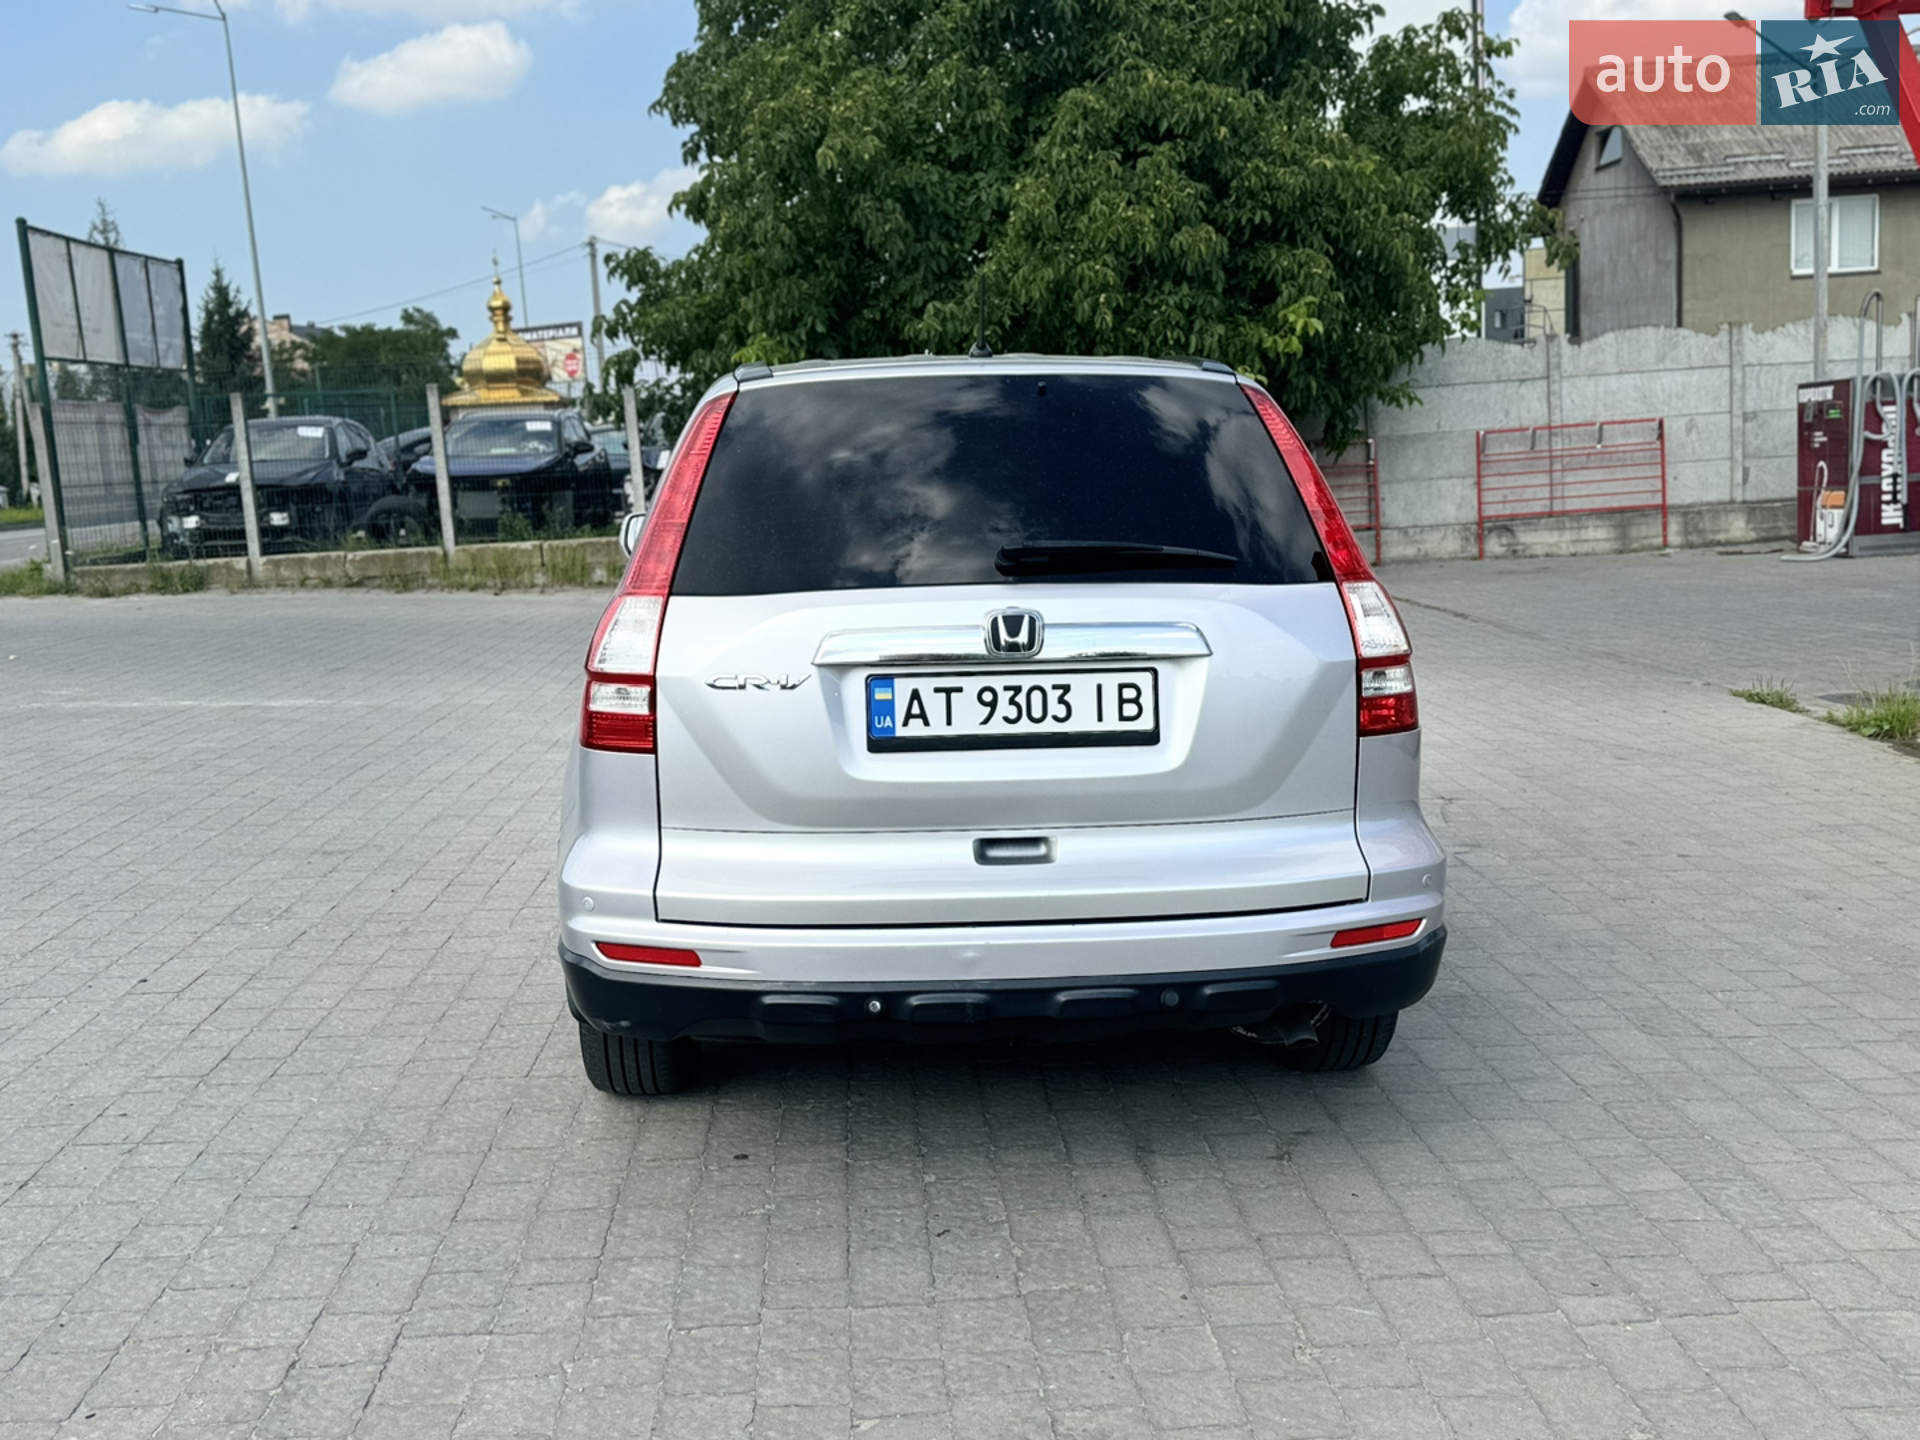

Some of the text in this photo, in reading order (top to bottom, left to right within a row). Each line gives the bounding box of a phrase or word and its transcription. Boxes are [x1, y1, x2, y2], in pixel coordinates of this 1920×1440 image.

[704, 674, 812, 691] CR-V
[901, 682, 1144, 727] AT 9303 IB
[874, 715, 893, 728] UA
